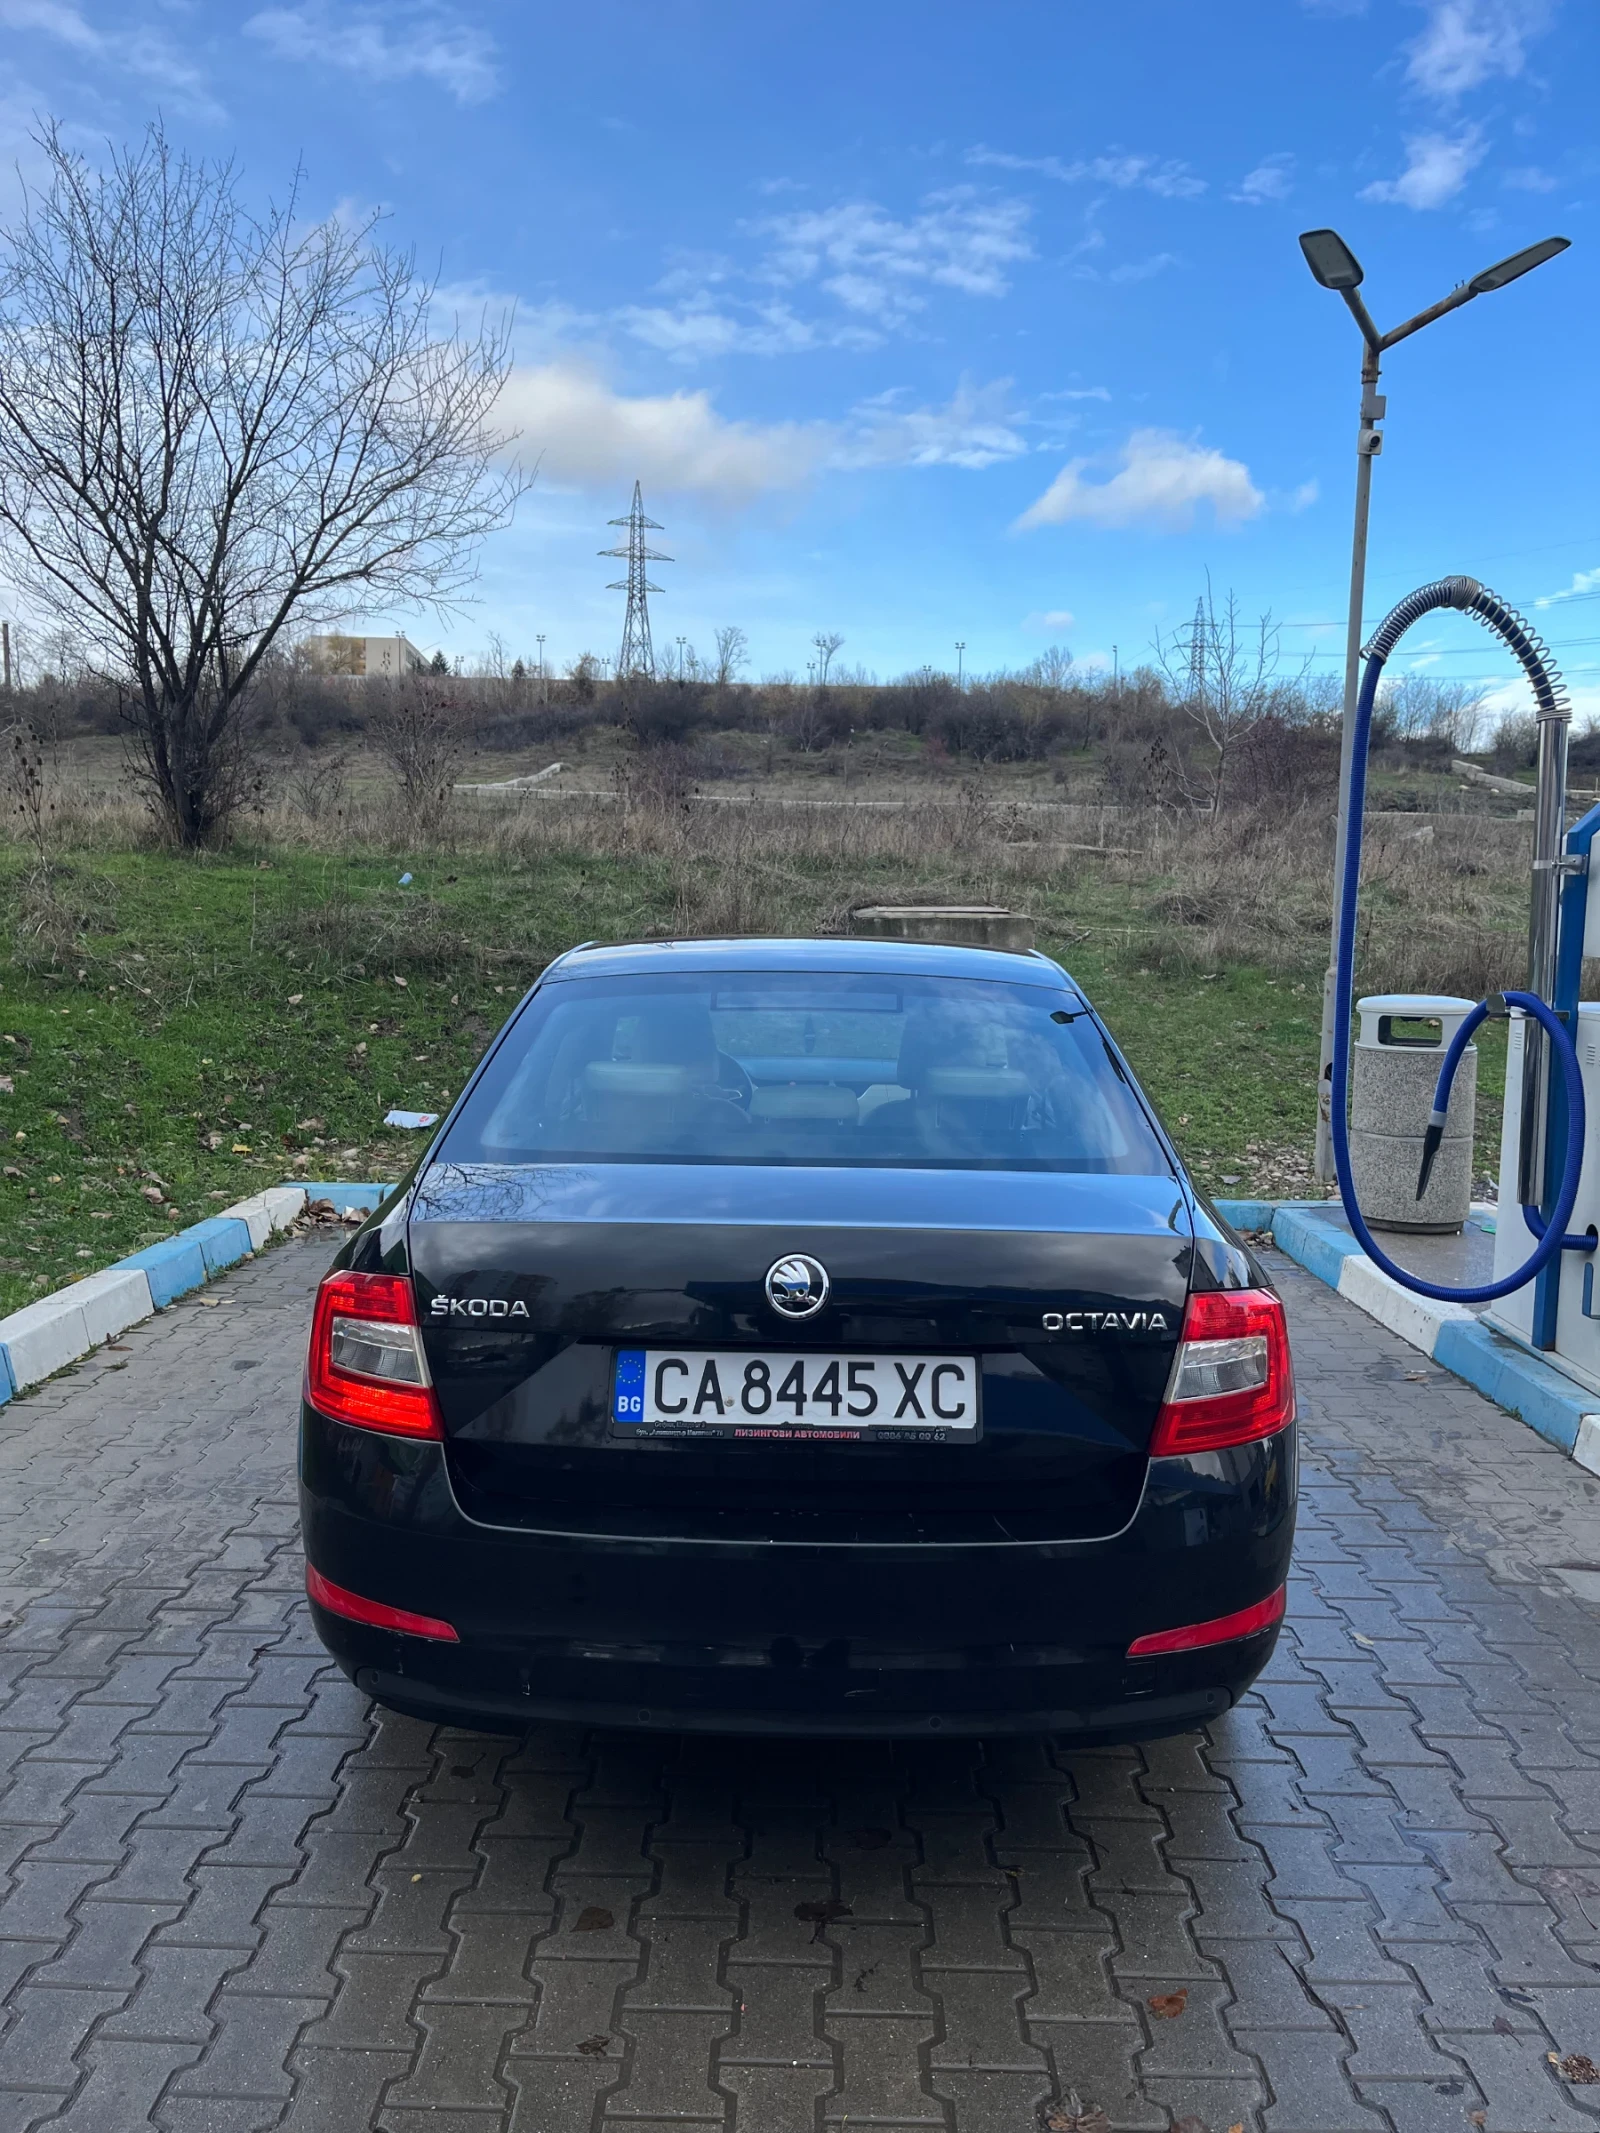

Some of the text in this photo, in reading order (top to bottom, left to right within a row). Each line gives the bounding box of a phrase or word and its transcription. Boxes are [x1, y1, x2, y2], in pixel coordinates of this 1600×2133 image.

[431, 1294, 531, 1318] ŠKODA
[1042, 1312, 1169, 1331] OCTAVIA
[654, 1358, 966, 1420] CA 8445 XC
[617, 1395, 641, 1413] BG
[734, 1428, 861, 1440] ЛИЗИНГОВИ АВТОМОБИЛИ
